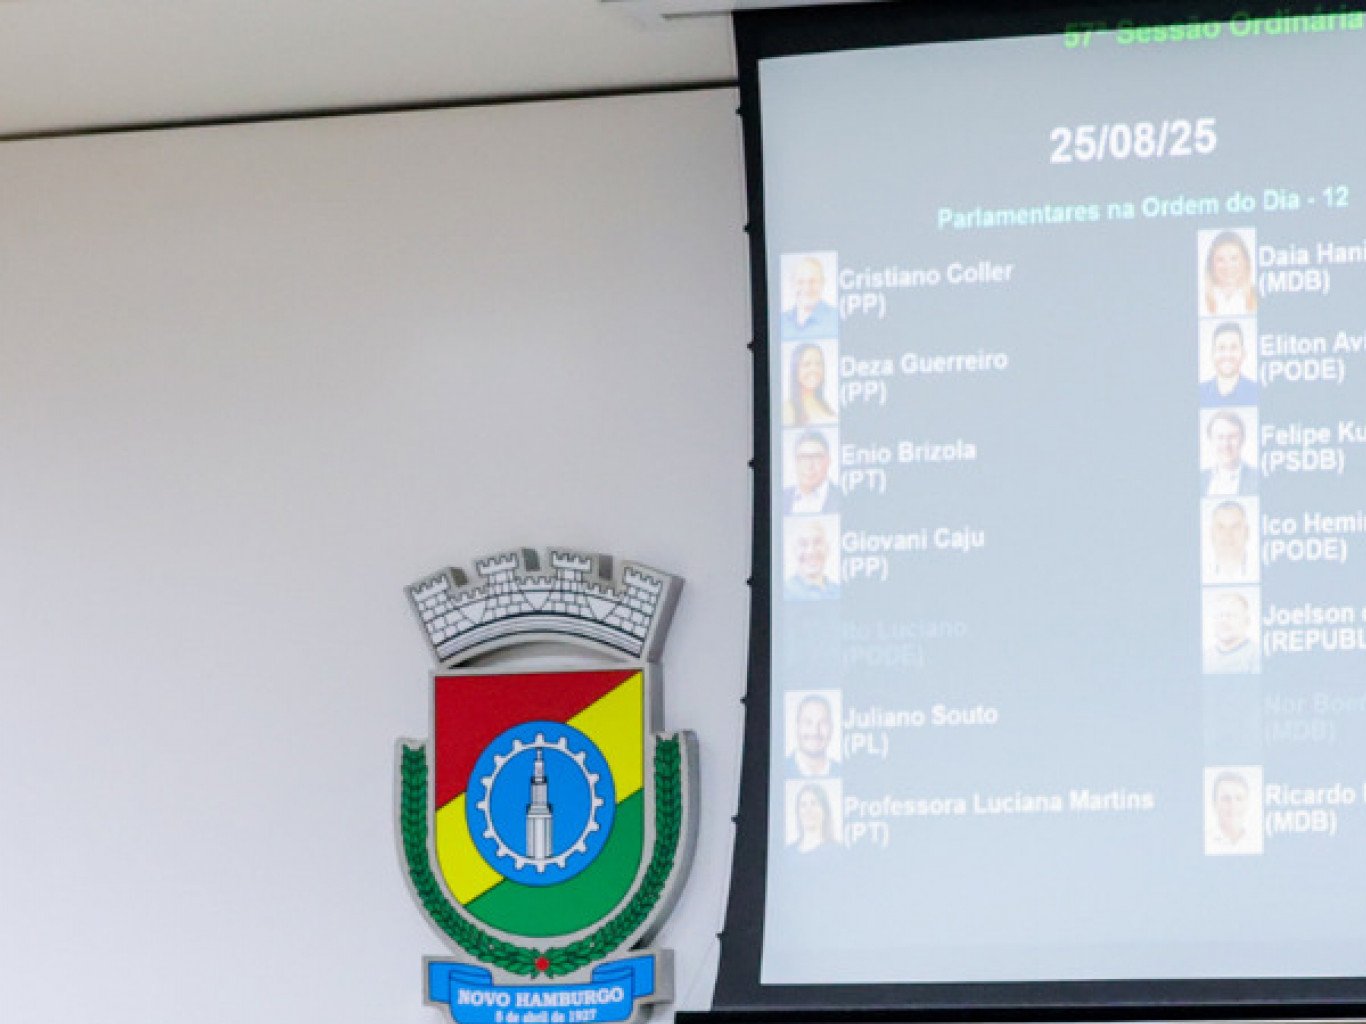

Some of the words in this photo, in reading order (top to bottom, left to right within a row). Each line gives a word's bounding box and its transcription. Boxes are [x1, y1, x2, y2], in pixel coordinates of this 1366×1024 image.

[1228, 4, 1364, 37] Ordinária
[1050, 117, 1218, 164] 25/08/25
[938, 200, 1098, 229] Parlamentares
[1107, 201, 1136, 219] na
[1141, 194, 1219, 217] Ordem
[1227, 191, 1256, 213] do
[1263, 187, 1300, 211] Dia
[1322, 185, 1349, 209] 12
[1260, 244, 1309, 266] Daia
[840, 265, 940, 290] Cristiano
[946, 259, 1016, 283] Coller
[1260, 271, 1330, 297] (MDB)
[840, 293, 887, 320] (PP)
[1261, 333, 1326, 356] Eliton
[840, 354, 894, 378] Deza
[901, 351, 1009, 375] Guerreiro
[1261, 358, 1346, 386] (PODE)
[840, 380, 888, 407] (PP)
[1261, 422, 1331, 449] Felipe
[841, 443, 892, 465] Enio
[897, 440, 978, 463] Brizola
[1261, 447, 1346, 477] (PSDB)
[841, 470, 887, 497] (PT)
[1263, 513, 1297, 536] Ico
[841, 529, 928, 553] Giovani
[935, 526, 985, 554] Caju
[1263, 537, 1347, 566] (PODE)
[841, 555, 888, 582] (PP)
[1263, 600, 1355, 626] Joelson
[842, 706, 925, 730] Juliano
[932, 703, 999, 726] Souto
[844, 732, 888, 759] (PL)
[842, 794, 966, 819] Professora
[974, 791, 1063, 814] Luciana
[1069, 788, 1155, 812] Martins
[1265, 781, 1356, 805] Ricardo
[844, 821, 889, 849] (PT)
[1265, 807, 1338, 837] (MDB)
[458, 988, 510, 1007] NOVO
[516, 986, 625, 1008] HAMBURGO
